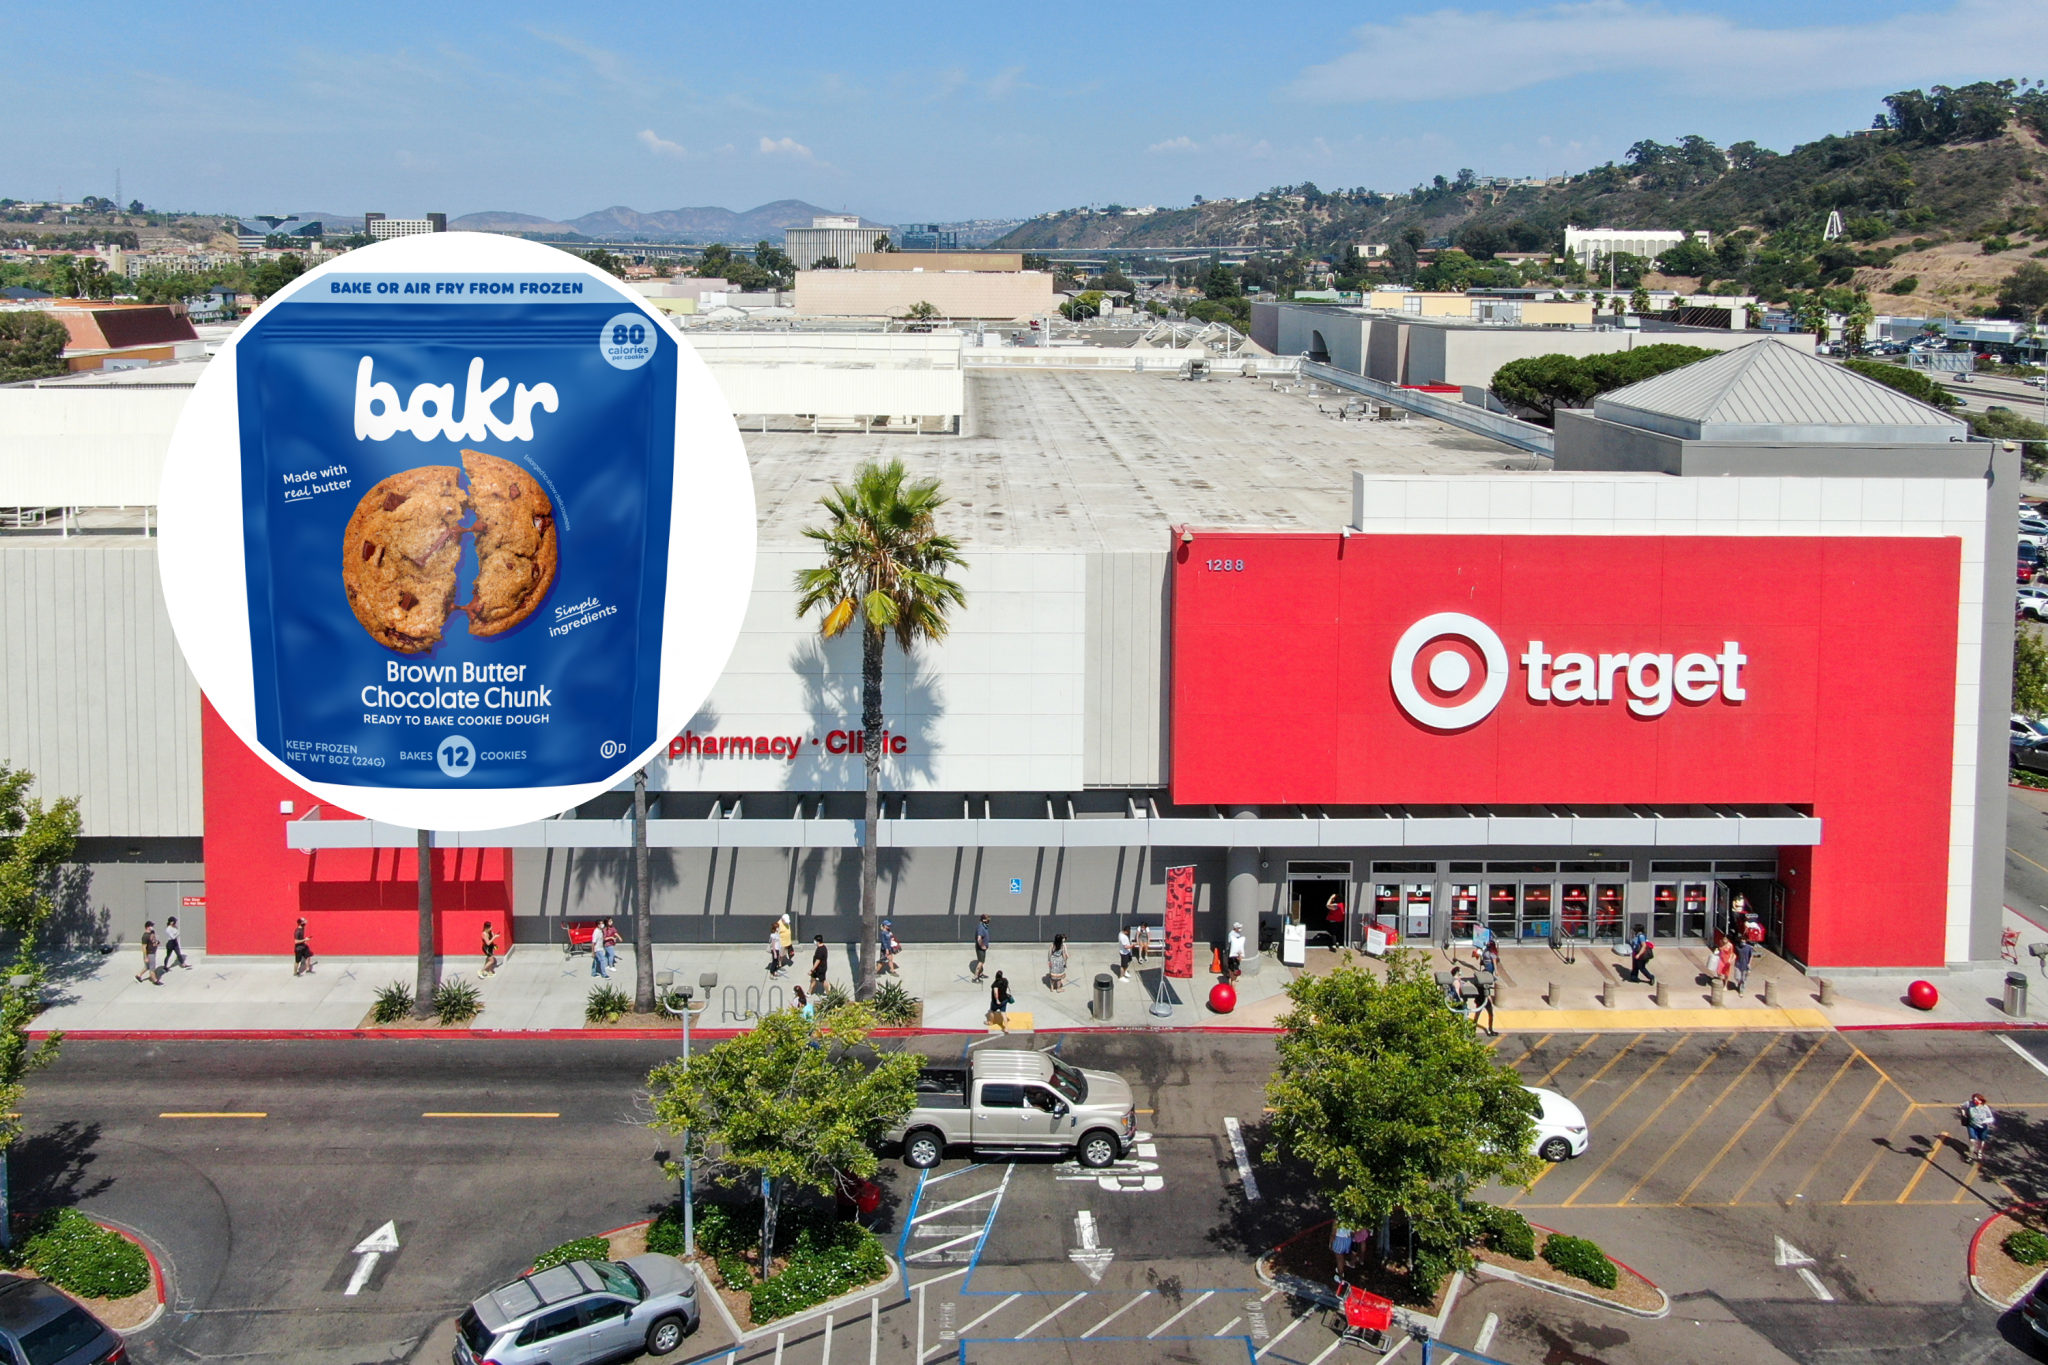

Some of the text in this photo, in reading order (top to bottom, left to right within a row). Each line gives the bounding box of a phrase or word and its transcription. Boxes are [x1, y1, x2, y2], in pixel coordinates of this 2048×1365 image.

[331, 282, 583, 294] BAKE OR AIR FRY FROM FROZEN
[612, 324, 645, 345] 80
[608, 345, 649, 355] calories
[354, 356, 559, 442] bakr
[283, 464, 348, 485] Made with
[284, 479, 352, 499] real butter
[1206, 559, 1245, 571] 1288
[554, 596, 600, 619] Simple
[548, 604, 618, 638] ingredients
[387, 660, 526, 683] Brown Butter
[1521, 640, 1747, 717] target
[361, 684, 552, 709] Chocolate Chunk
[363, 714, 550, 726] READY TO BAKE COOKIE DOUGH
[286, 740, 358, 754] KEEP FROZEN
[669, 729, 907, 760] pharmacy Cliic
[287, 751, 308, 762] NET
[310, 753, 326, 764] WT
[352, 756, 386, 768] (224G)
[400, 745, 527, 767] BAKES 12 COOKIES
[1052, 1131, 1164, 1191] OP
